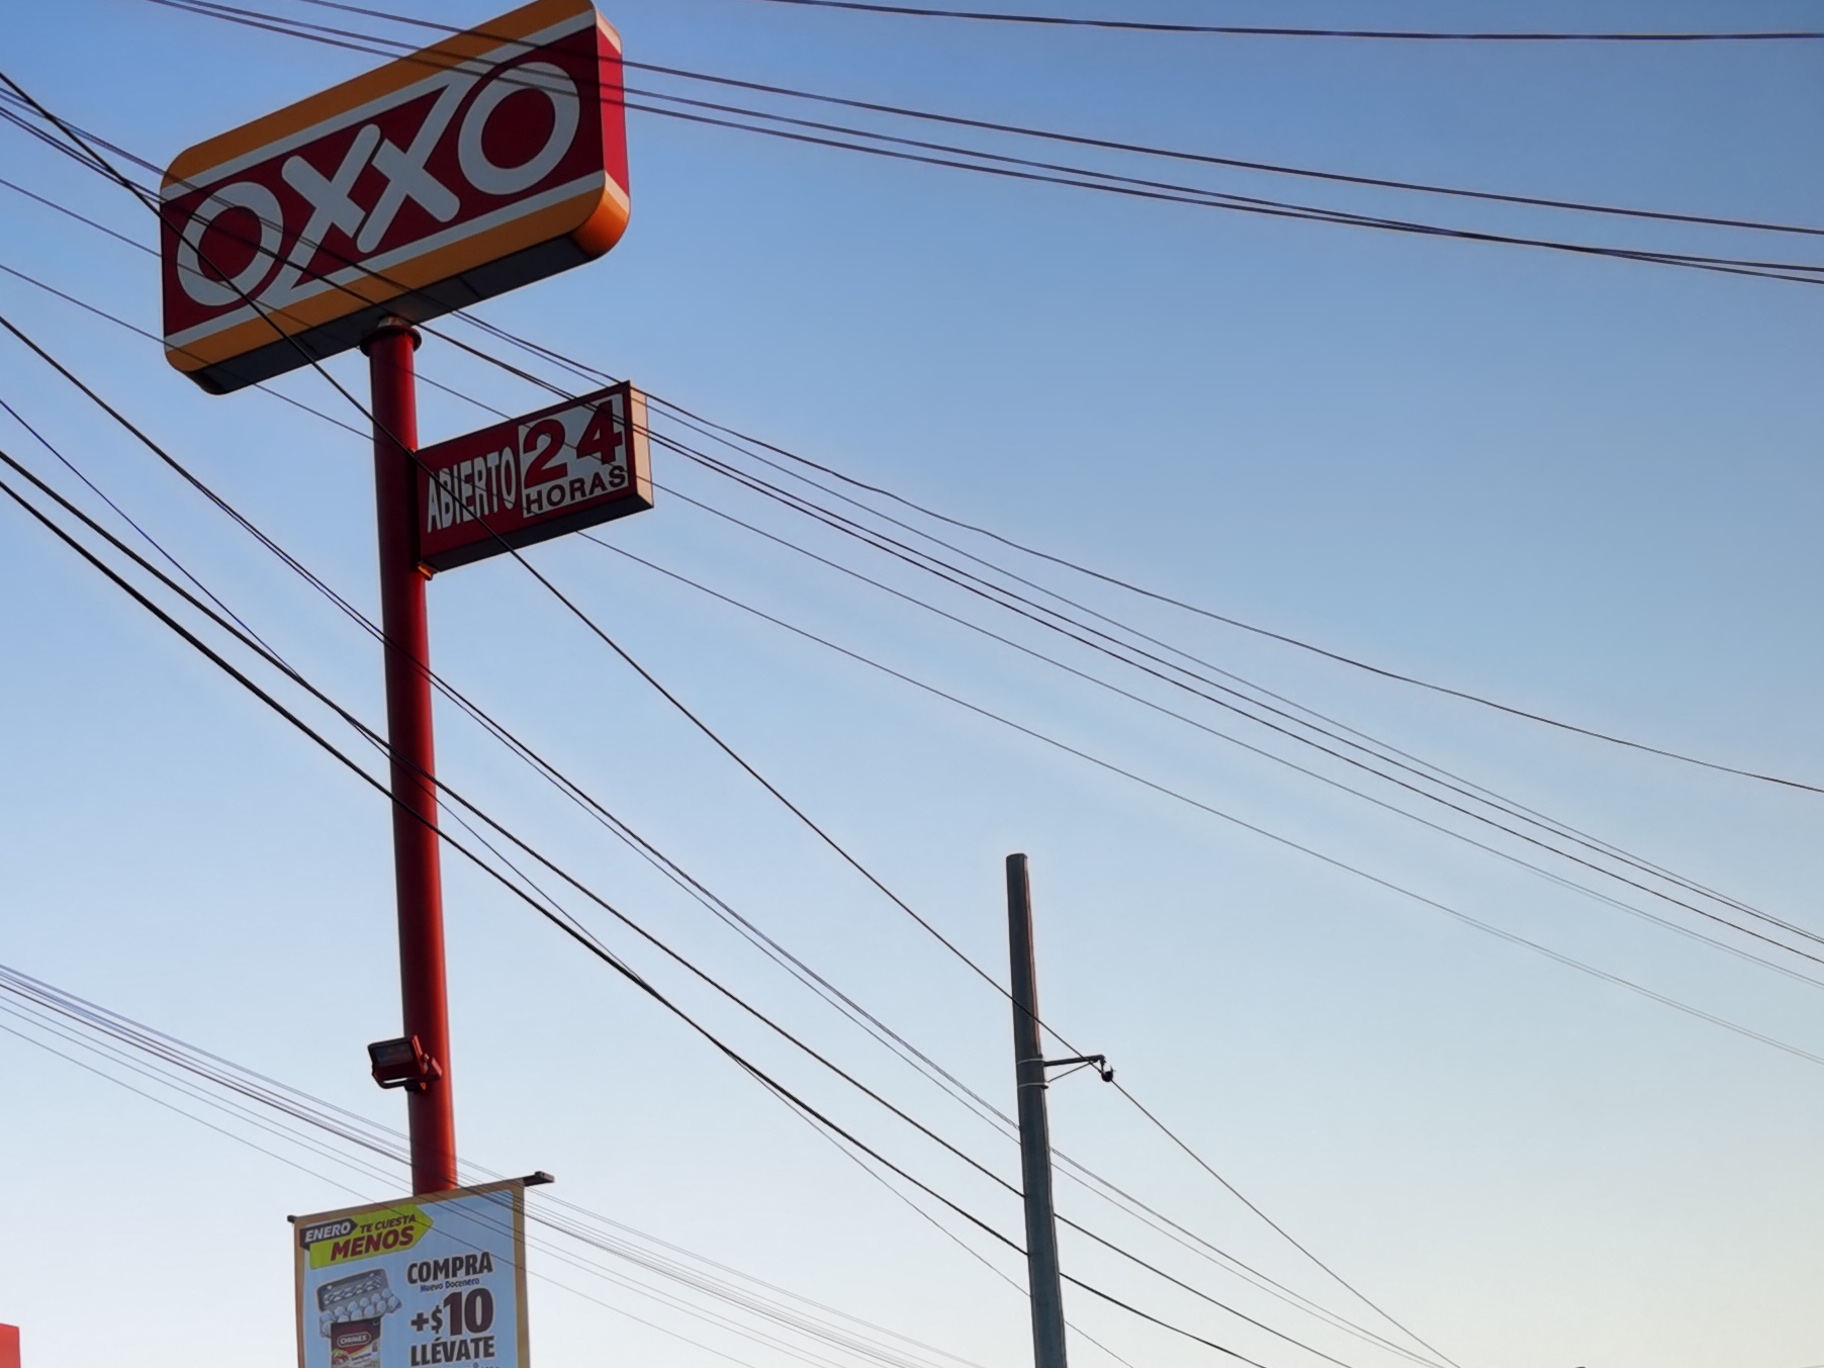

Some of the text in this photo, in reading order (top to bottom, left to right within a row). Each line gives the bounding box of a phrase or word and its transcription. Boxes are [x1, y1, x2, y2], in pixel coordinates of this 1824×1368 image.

[177, 62, 580, 306] OXXO
[523, 400, 624, 489] 24
[428, 446, 516, 534] ABIERTO
[525, 465, 627, 517] HORAS
[304, 1221, 352, 1244] ENERO
[360, 1214, 416, 1234] TE CUESTA
[330, 1225, 415, 1261] MENOS
[407, 1251, 494, 1285] COMPRA
[411, 1336, 495, 1367] LLÉVATE
